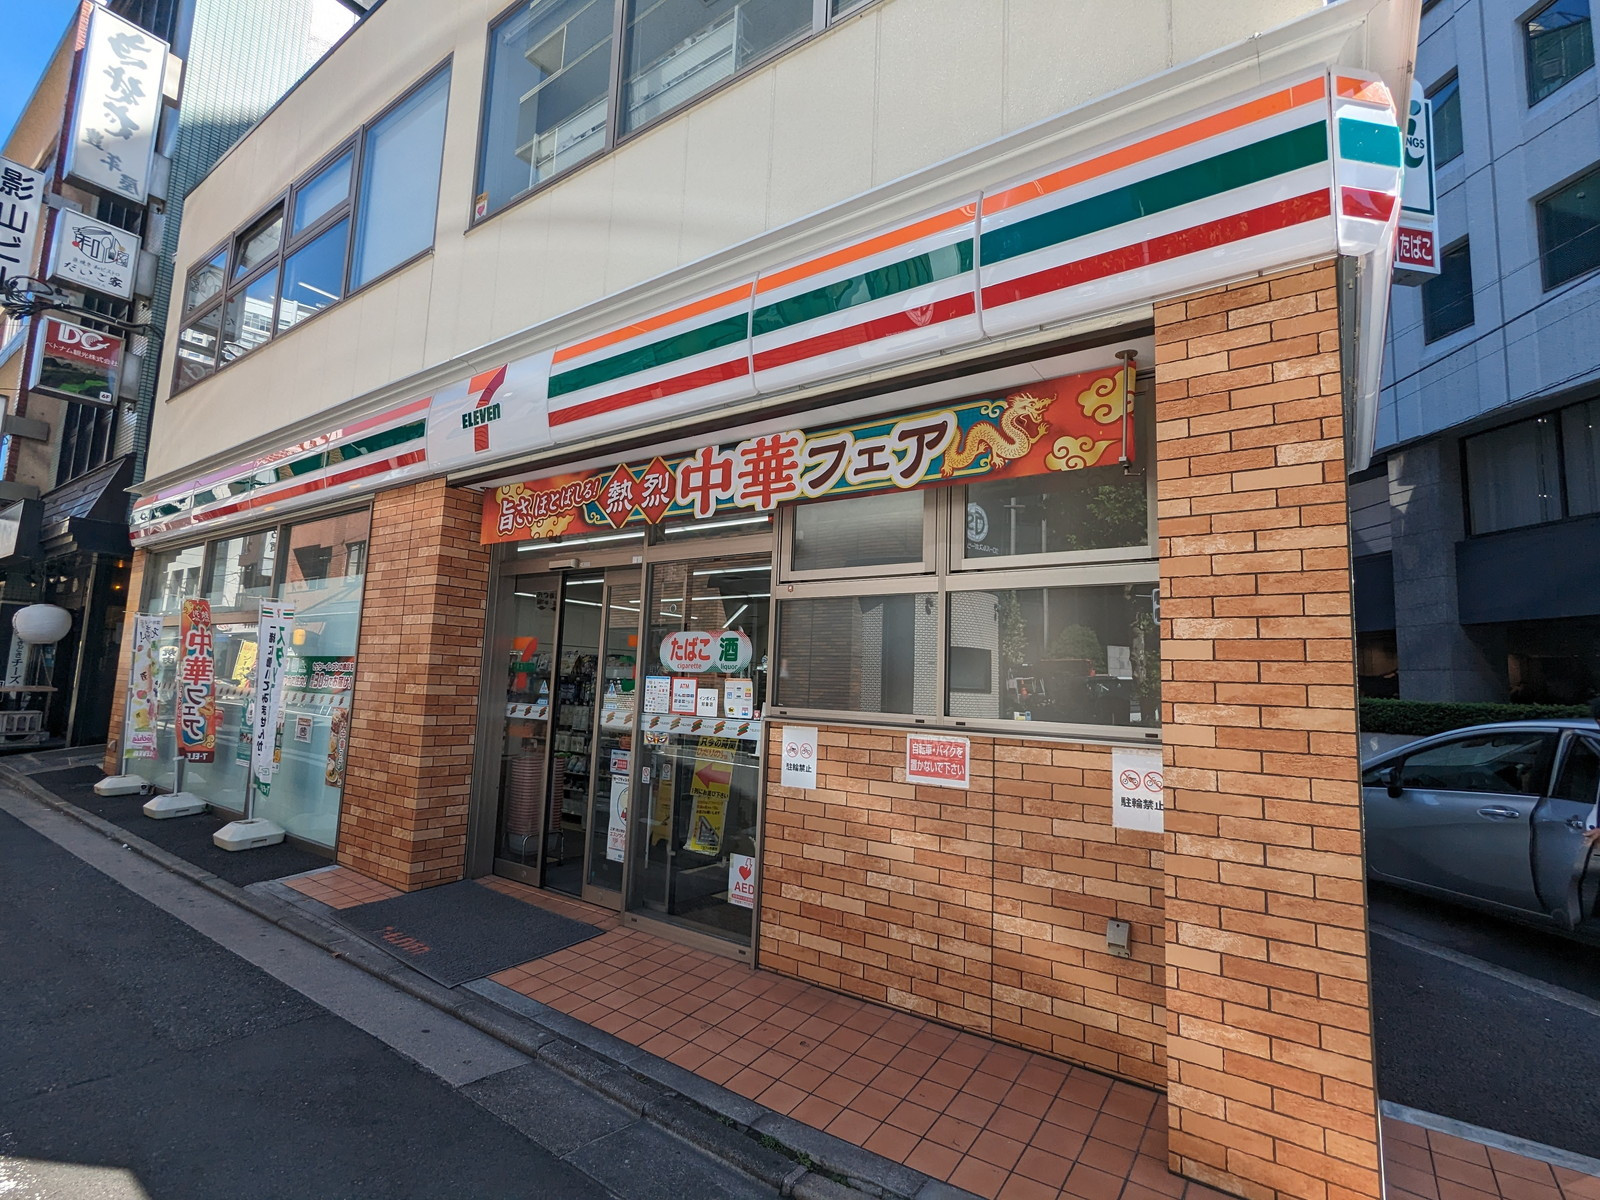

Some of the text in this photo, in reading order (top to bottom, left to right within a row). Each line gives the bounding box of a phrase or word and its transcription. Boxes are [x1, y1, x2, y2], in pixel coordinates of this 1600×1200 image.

[1400, 233, 1433, 260] たばこ
[606, 420, 949, 515] 熱烈 中華フェア
[670, 637, 739, 662] たばこ 酒
[677, 662, 738, 670] cigarette liquor
[1121, 797, 1164, 811] 駐輪禁止
[734, 881, 755, 895] AED
